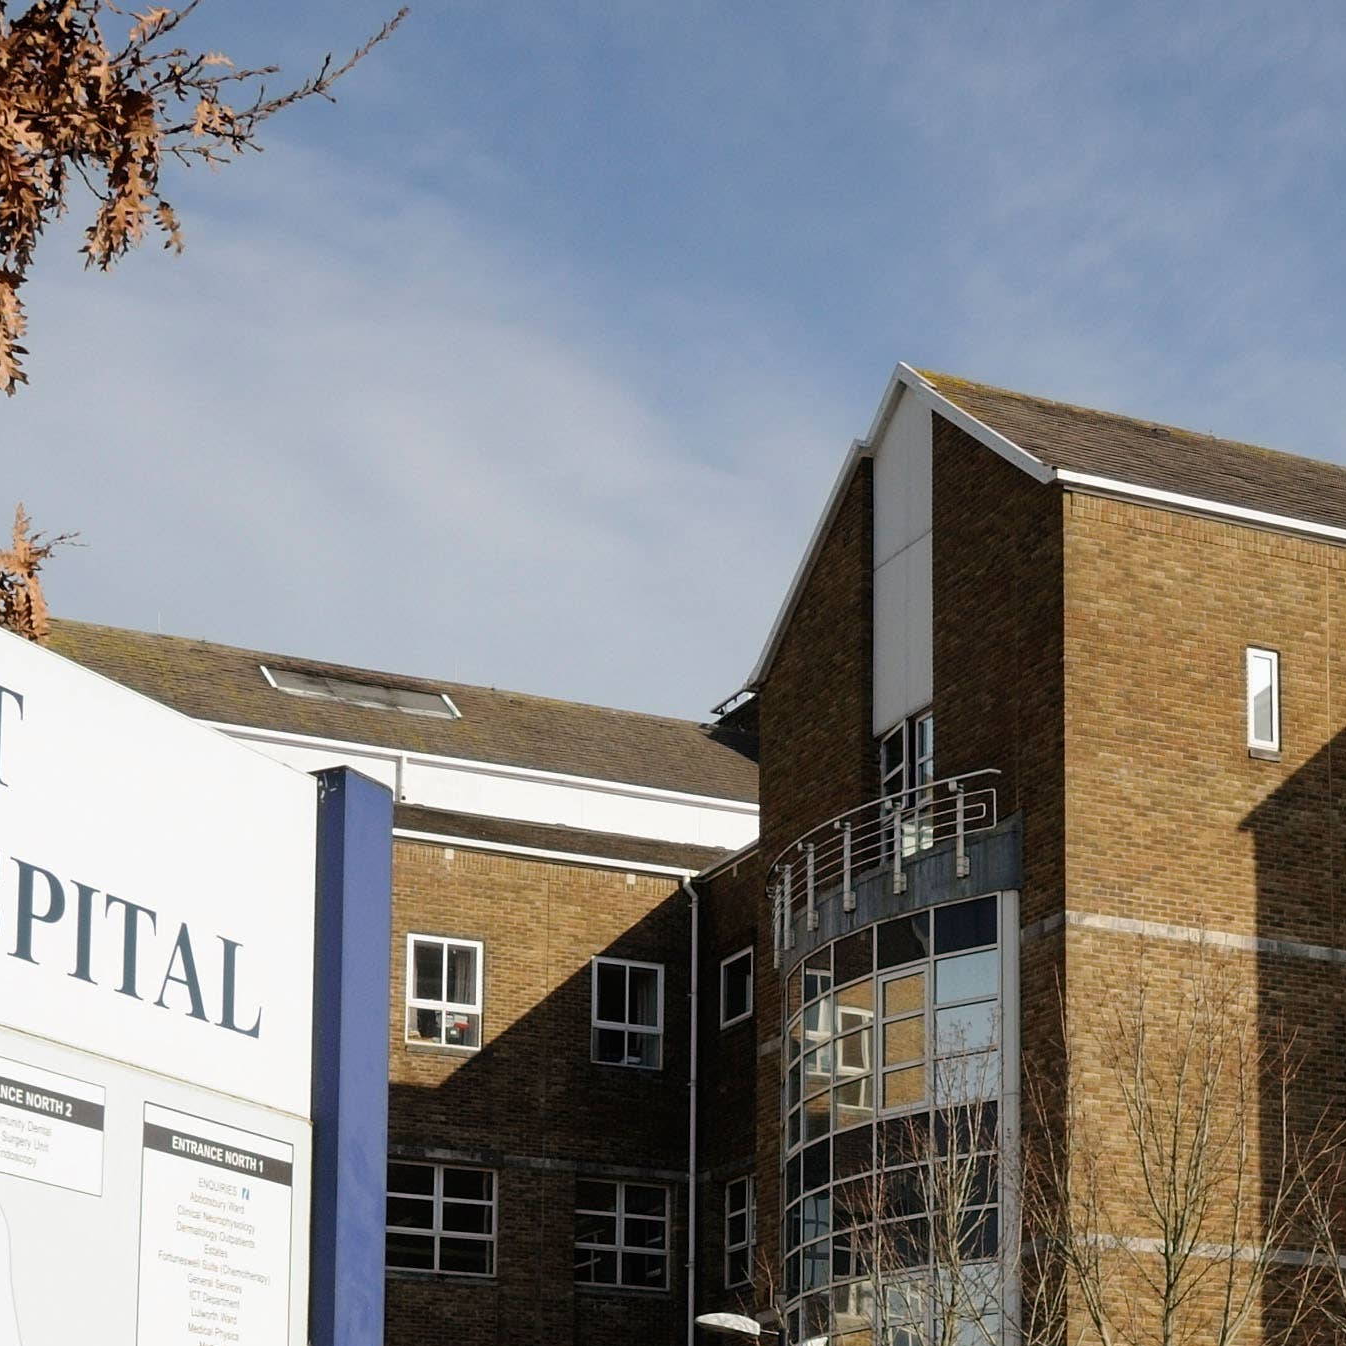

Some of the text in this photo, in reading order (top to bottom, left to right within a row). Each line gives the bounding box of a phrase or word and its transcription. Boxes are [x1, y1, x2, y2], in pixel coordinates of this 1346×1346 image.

[25, 1091, 63, 1114] NORTH
[65, 1102, 72, 1117] 2
[171, 1135, 263, 1172] ENTRANCE NORTH 1
